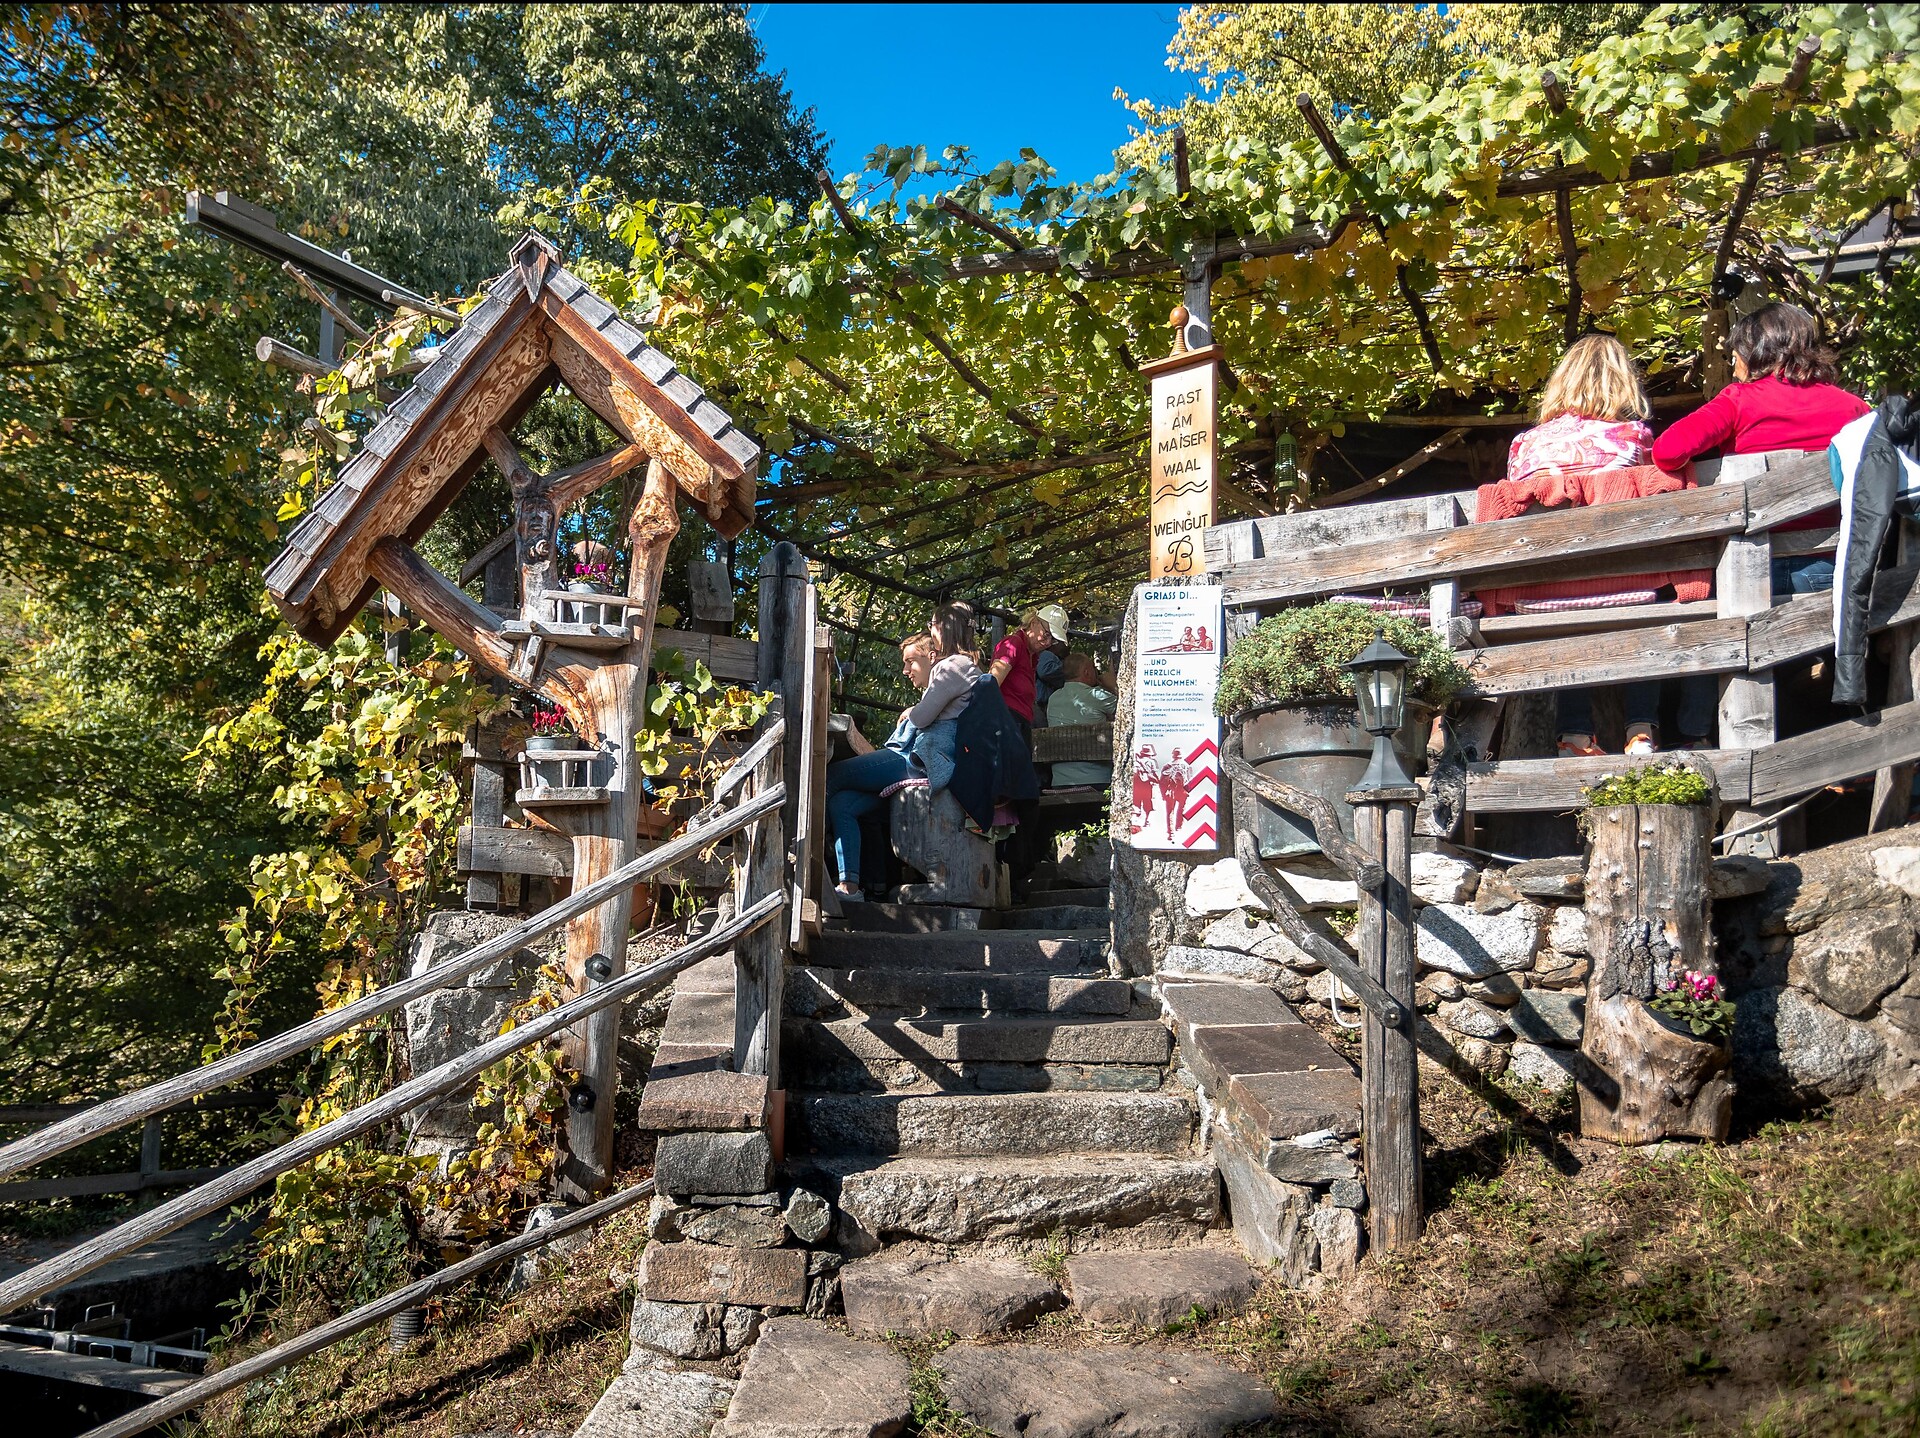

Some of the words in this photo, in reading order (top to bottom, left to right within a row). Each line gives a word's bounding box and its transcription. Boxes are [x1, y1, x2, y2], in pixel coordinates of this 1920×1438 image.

[1166, 389, 1202, 409] RAST
[1171, 414, 1193, 430] AM
[1163, 458, 1201, 477] WAAL
[1163, 535, 1194, 574] B
[1144, 591, 1176, 600] GRIASS
[1143, 679, 1197, 687] WILLKOMMEN!
